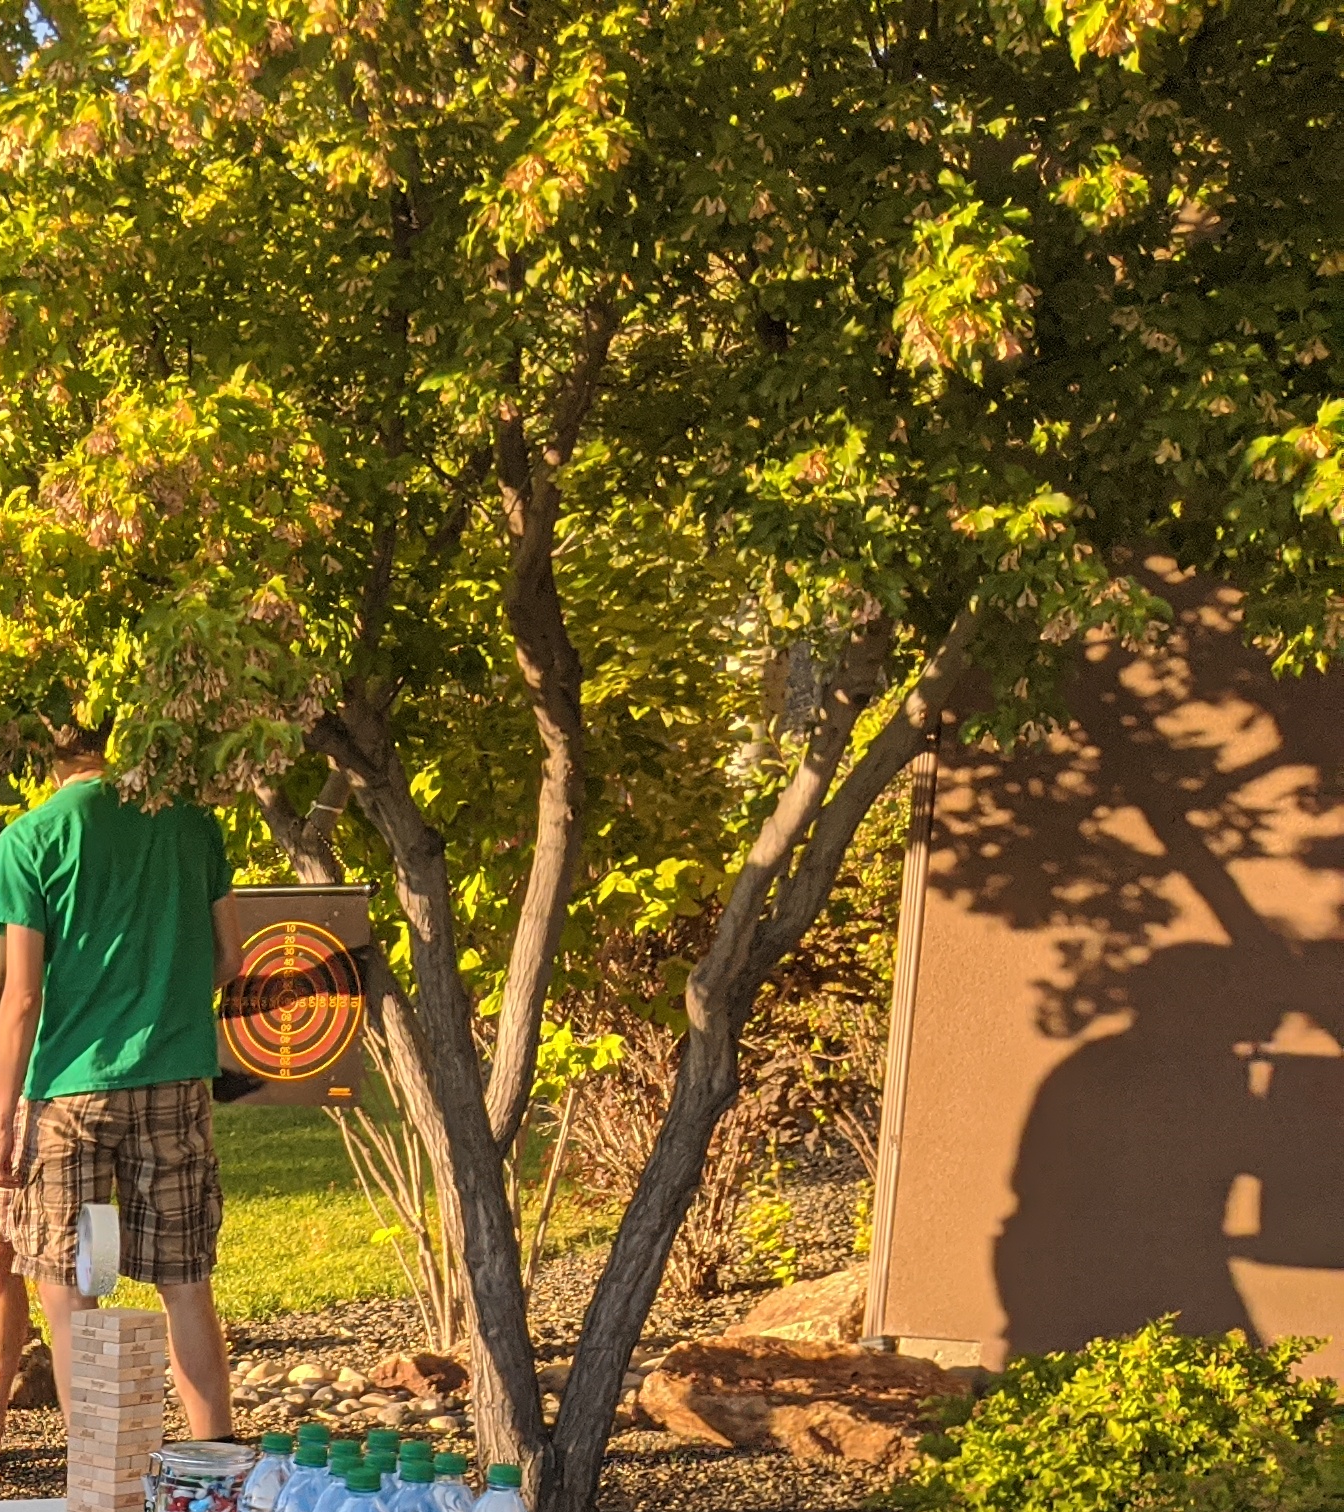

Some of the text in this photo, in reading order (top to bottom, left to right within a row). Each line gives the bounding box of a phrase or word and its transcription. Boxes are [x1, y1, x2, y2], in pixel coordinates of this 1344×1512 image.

[286, 924, 296, 933] 10
[284, 935, 296, 944] 20
[284, 947, 295, 956] 30
[284, 958, 294, 966] 40
[329, 995, 337, 1008] 30
[350, 997, 359, 1008] 10
[280, 1023, 292, 1032] 60
[279, 1035, 291, 1044] 40
[279, 1046, 291, 1055] 30
[279, 1057, 291, 1066] 20
[279, 1068, 290, 1077] 10
